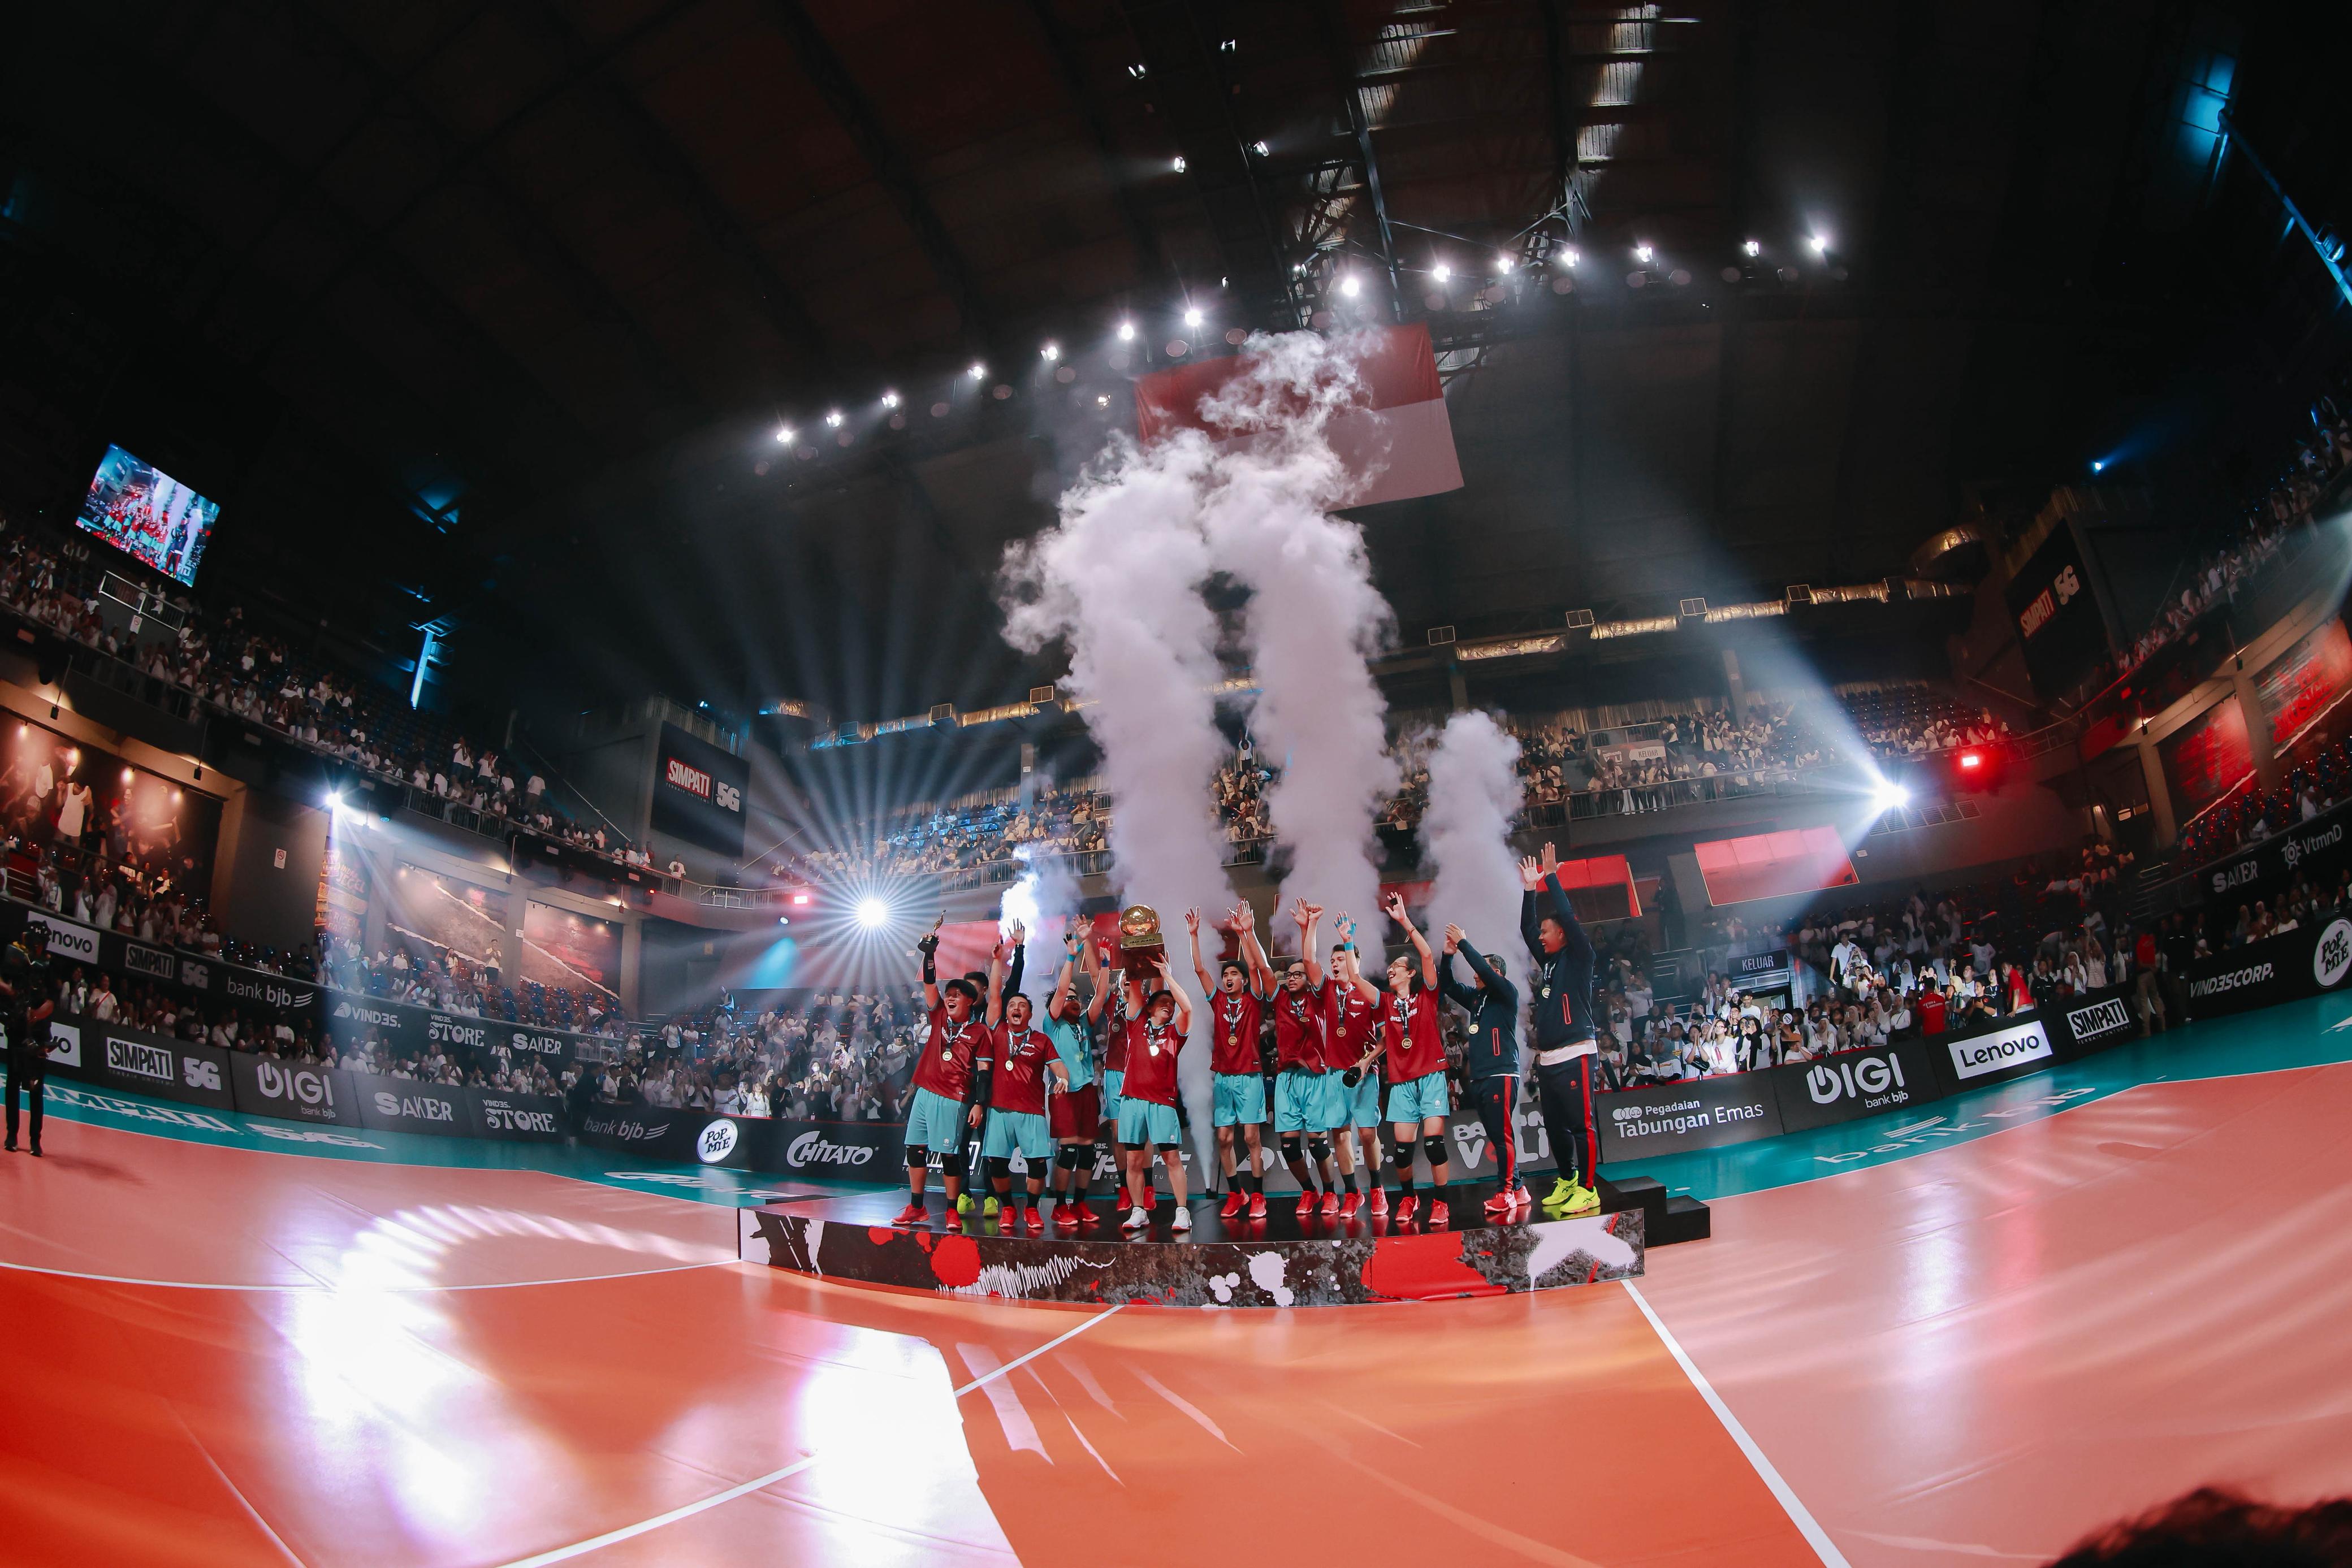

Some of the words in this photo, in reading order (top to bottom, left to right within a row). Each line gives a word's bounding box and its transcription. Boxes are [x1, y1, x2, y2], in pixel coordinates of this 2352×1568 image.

[2021, 590, 2054, 637] SIMPATI
[2054, 565, 2079, 605] 5G
[1638, 749, 1658, 758] KELUAR
[669, 761, 710, 796] SIMPATI
[716, 782, 740, 812] 5G
[2212, 860, 2258, 893] SAKER
[50, 928, 92, 954] novo
[128, 947, 171, 977] SIMPATI
[181, 961, 207, 989] 5G
[1742, 955, 1774, 971] KELUAR
[228, 977, 263, 1000] bank
[266, 986, 292, 1006] bjb
[2070, 1000, 2126, 1036] SIMPATI
[429, 1022, 485, 1047] STORE
[513, 1033, 562, 1055] SAKER
[1959, 1034, 2039, 1068] Lenovo
[110, 1041, 171, 1077] SIMPATI
[183, 1057, 222, 1090] 5G
[301, 1105, 321, 1115] bank
[322, 1109, 336, 1118] bjb
[374, 1092, 453, 1121] SAKER
[1645, 1100, 1700, 1115] Pegadaian
[1865, 1094, 1891, 1108] bank
[1891, 1090, 1909, 1103] bjb
[486, 1108, 555, 1133] STORE
[584, 1115, 615, 1134] bank
[617, 1117, 644, 1141] bjb
[1615, 1113, 1710, 1138] Tabungan
[1715, 1103, 1764, 1124] Emas
[705, 1128, 728, 1144] POP
[706, 1137, 730, 1153] MIE
